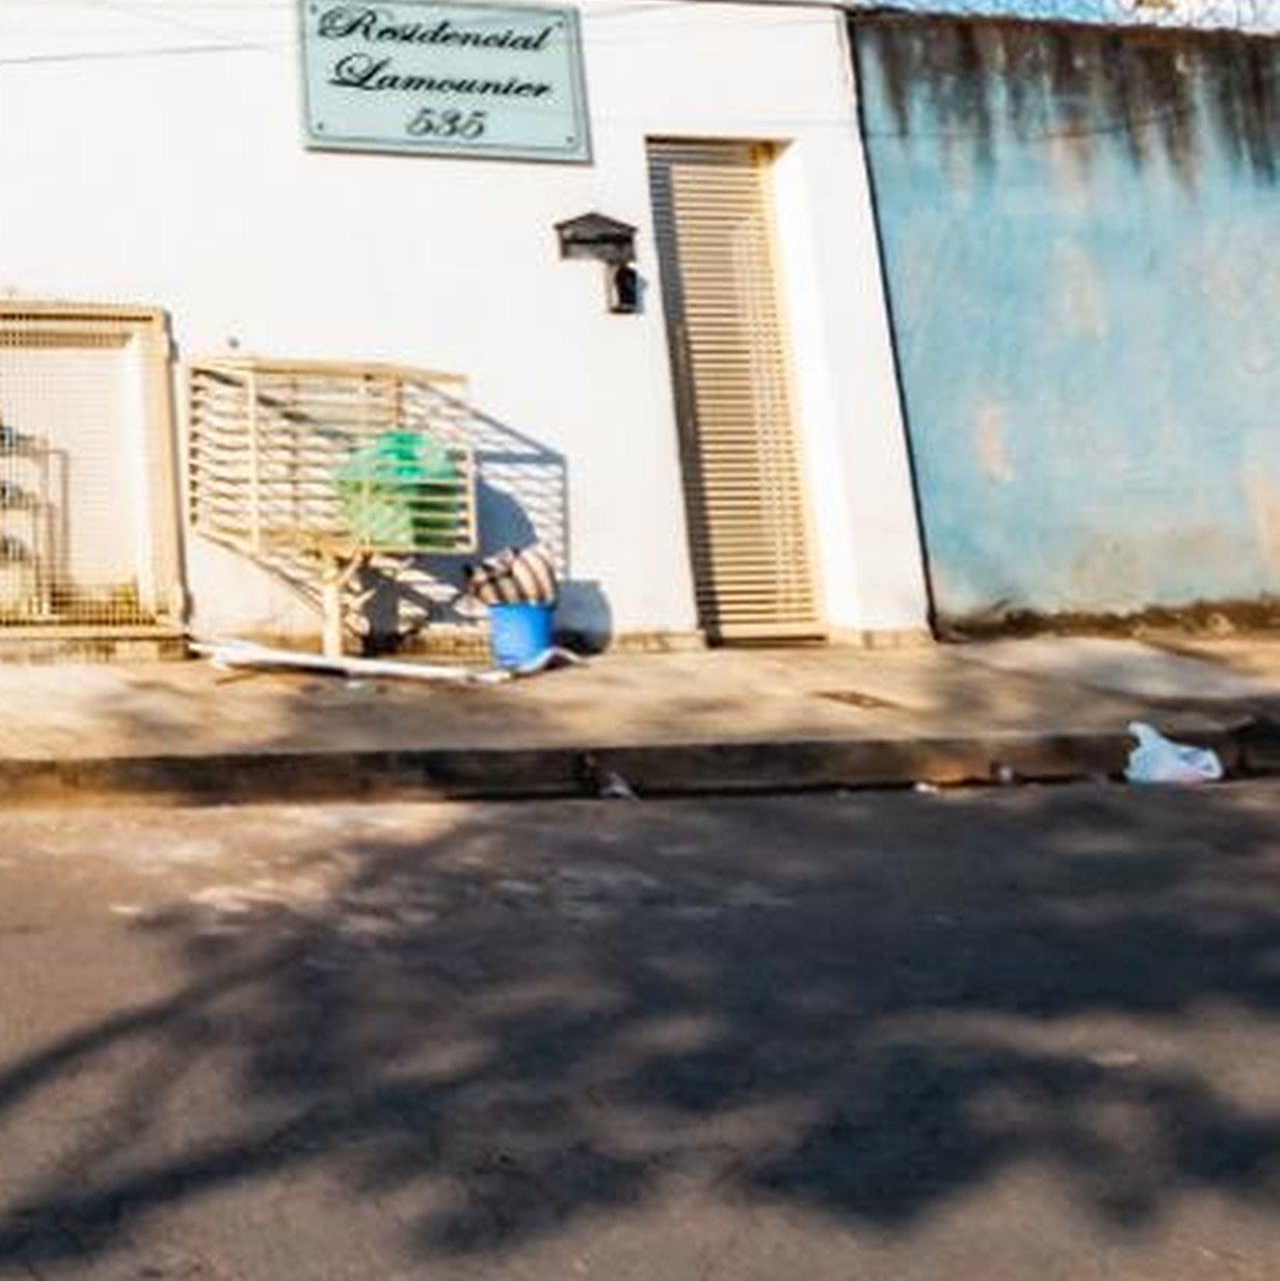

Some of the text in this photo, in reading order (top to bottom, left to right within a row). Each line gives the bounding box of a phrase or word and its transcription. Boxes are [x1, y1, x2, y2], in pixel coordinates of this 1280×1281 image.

[318, 6, 552, 51] Residencial
[327, 52, 552, 97] Lamounier
[406, 108, 487, 139] 535
